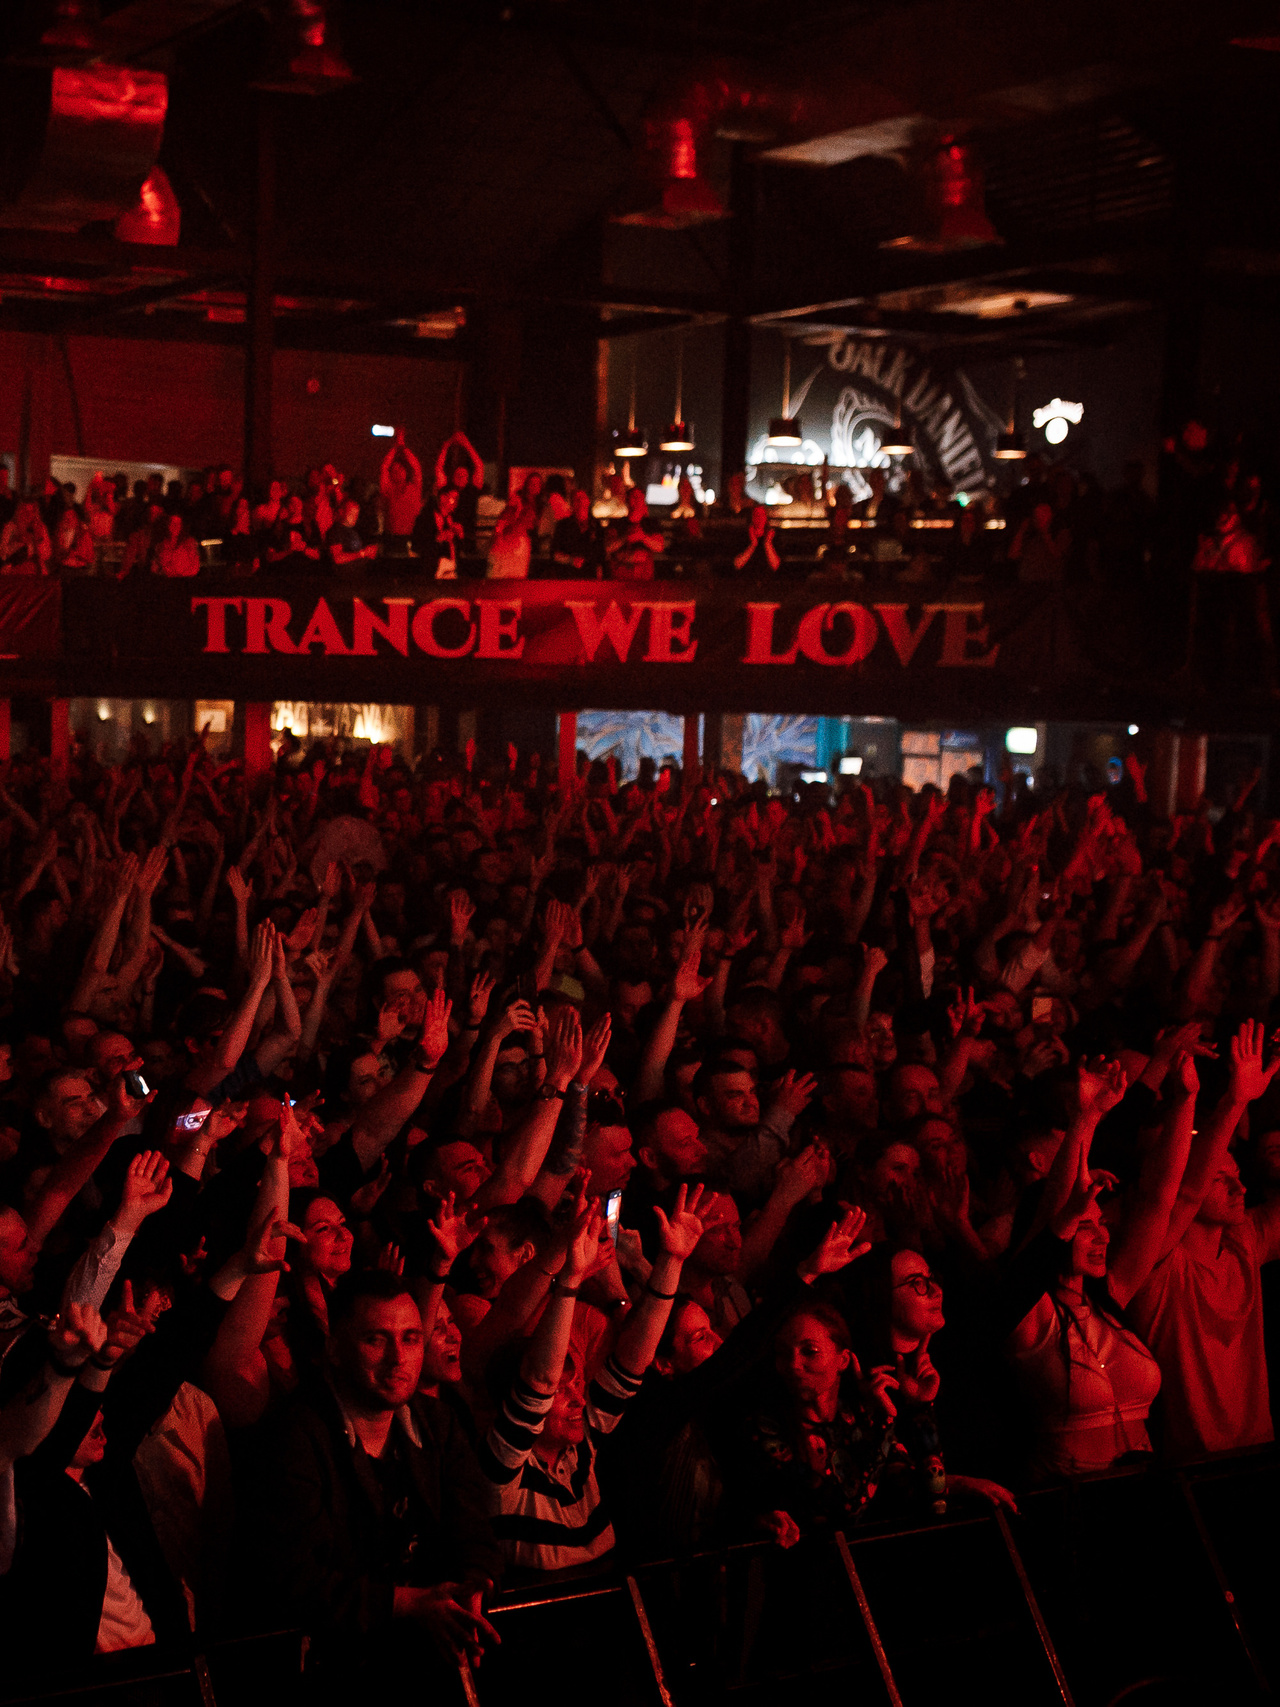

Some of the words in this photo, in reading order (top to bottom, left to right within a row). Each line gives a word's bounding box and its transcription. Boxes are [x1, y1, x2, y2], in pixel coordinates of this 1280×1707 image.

[191, 596, 526, 660] TRANCE
[564, 600, 699, 664] WE
[741, 600, 1002, 668] LOVE
